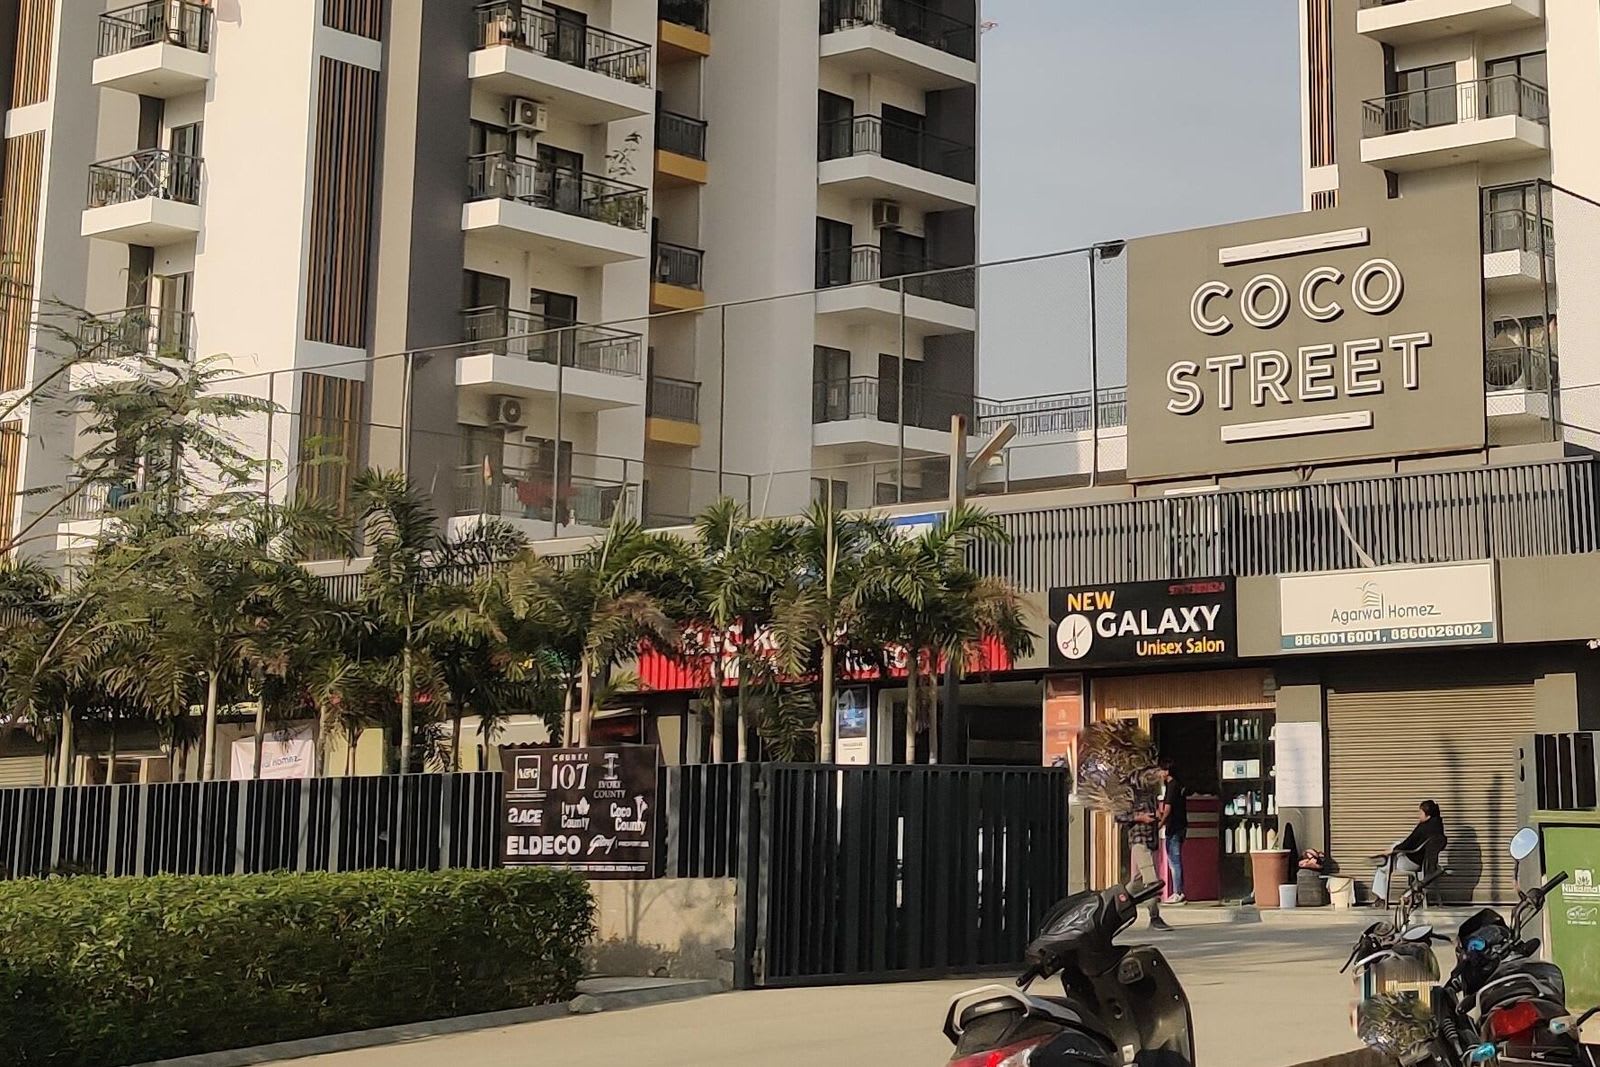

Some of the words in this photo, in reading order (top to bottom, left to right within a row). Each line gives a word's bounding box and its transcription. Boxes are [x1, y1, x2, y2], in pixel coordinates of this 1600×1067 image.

[1190, 258, 1404, 335] COCO
[1166, 332, 1432, 415] STREET
[1067, 590, 1115, 612] NEW
[1330, 593, 1385, 625] Agarwal
[1388, 603, 1441, 619] Homez
[1096, 604, 1220, 638] GALAXY
[1136, 640, 1182, 657] Unisex
[1186, 636, 1226, 654] Salon
[551, 763, 590, 790] 107
[593, 790, 626, 799] COUNTY
[561, 801, 576, 818] Ivy
[610, 802, 632, 818] Coco
[561, 815, 590, 831] County
[615, 817, 647, 836] County
[506, 835, 581, 856] ELDECO
